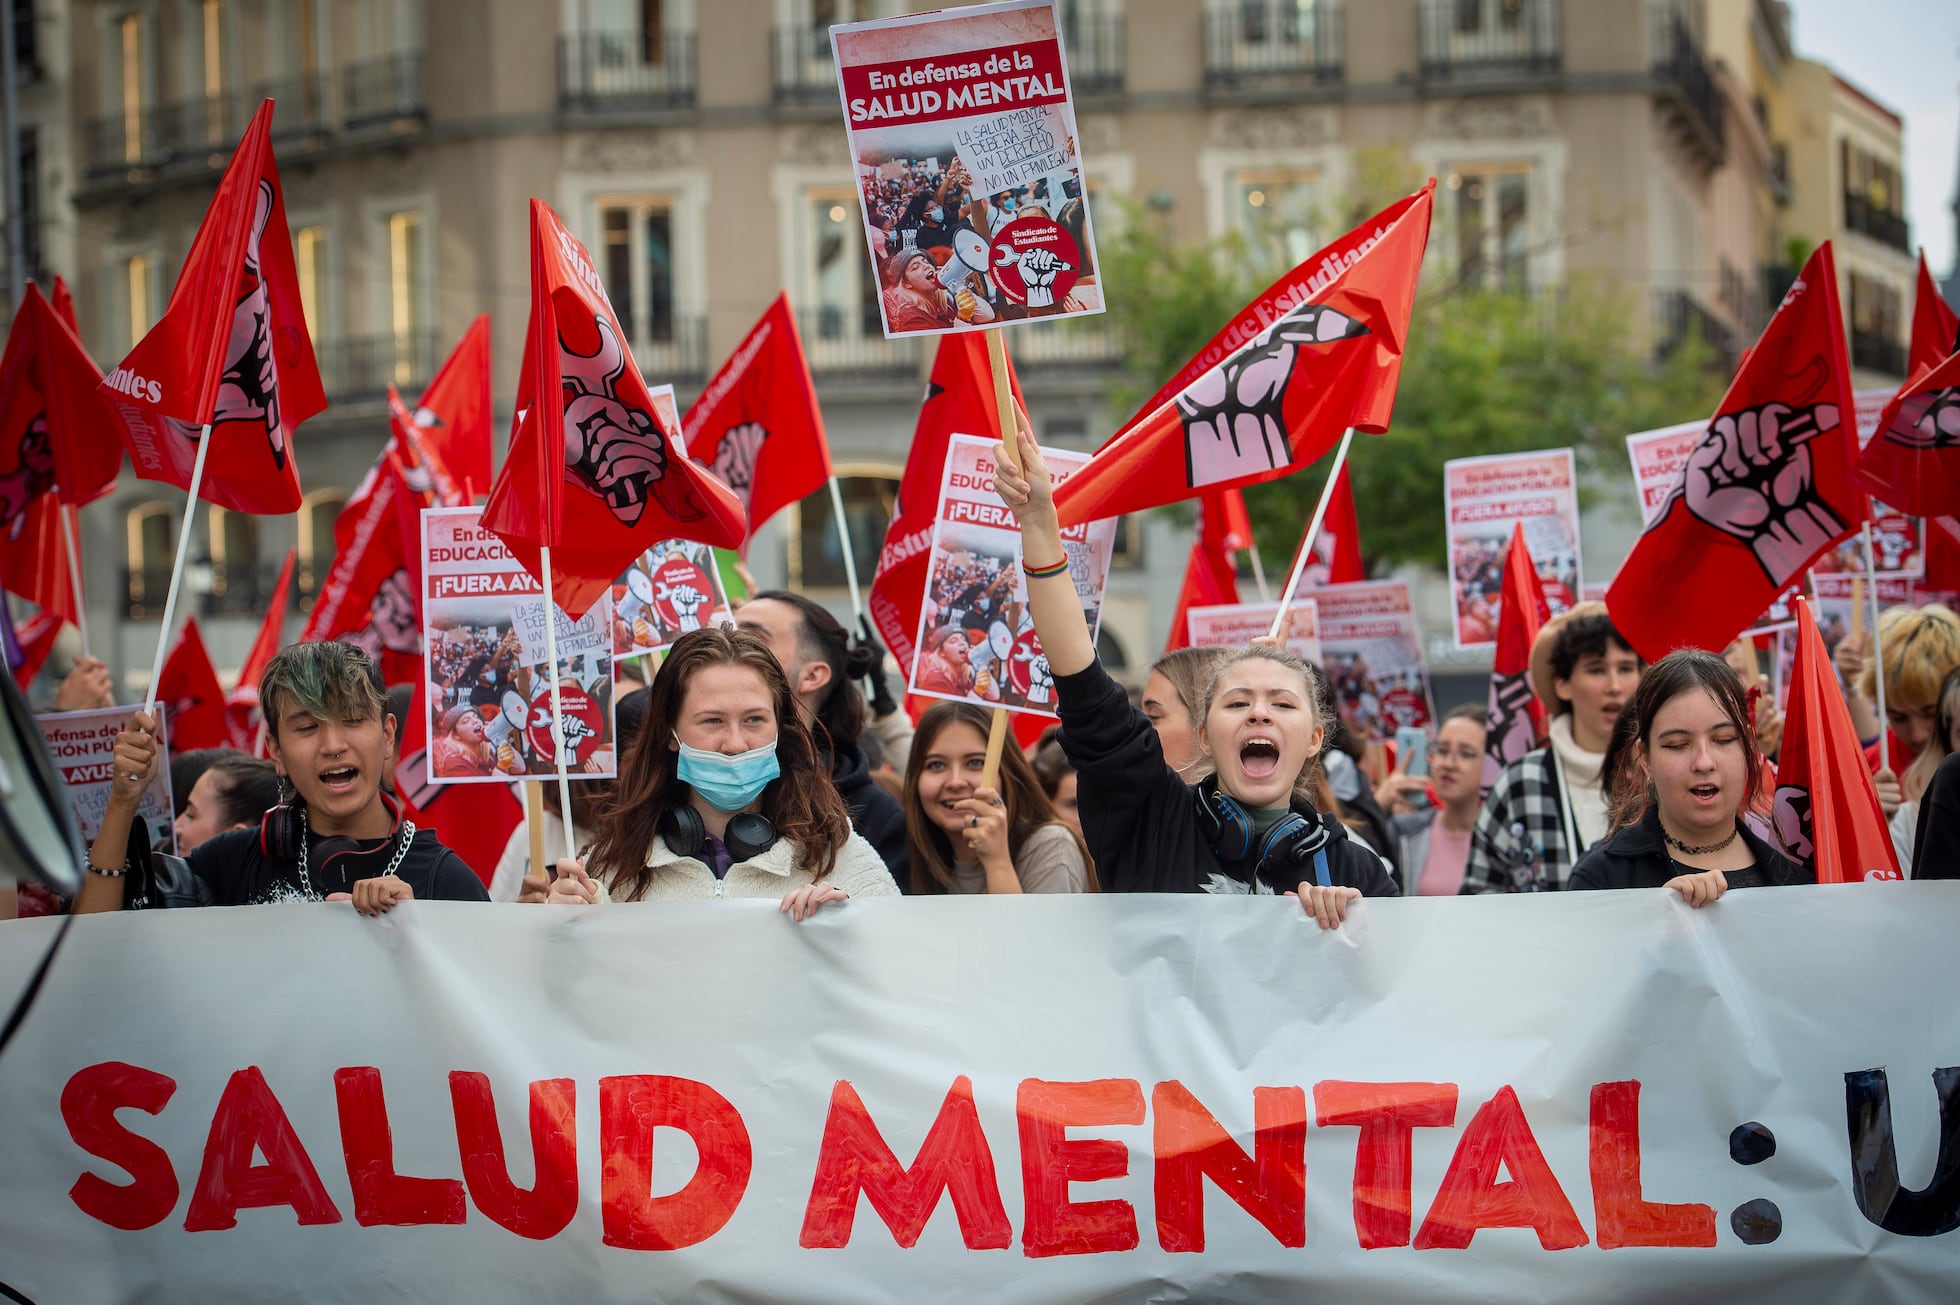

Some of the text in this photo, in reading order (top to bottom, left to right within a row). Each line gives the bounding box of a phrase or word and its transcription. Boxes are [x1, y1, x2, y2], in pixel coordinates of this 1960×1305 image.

[868, 50, 1034, 91] En defensa de la
[850, 72, 1065, 122] SALUD MENTAL
[956, 105, 1052, 146] LA SALUD MENTAL
[1021, 119, 1048, 141] SER
[976, 131, 1055, 171] UN DERECHO
[984, 174, 1002, 193] NO
[1002, 167, 1020, 187] UN
[1011, 226, 1057, 239] Sindicato de
[1013, 234, 1059, 246] Estudiantes
[1222, 318, 1259, 352] de
[975, 458, 995, 474] En
[452, 527, 473, 542] En
[435, 574, 507, 598] ¡FUERA
[514, 605, 527, 620] LA
[527, 631, 542, 642] UN
[531, 646, 546, 661] NO
[98, 724, 119, 738] de
[60, 1061, 753, 1251] SALUD
